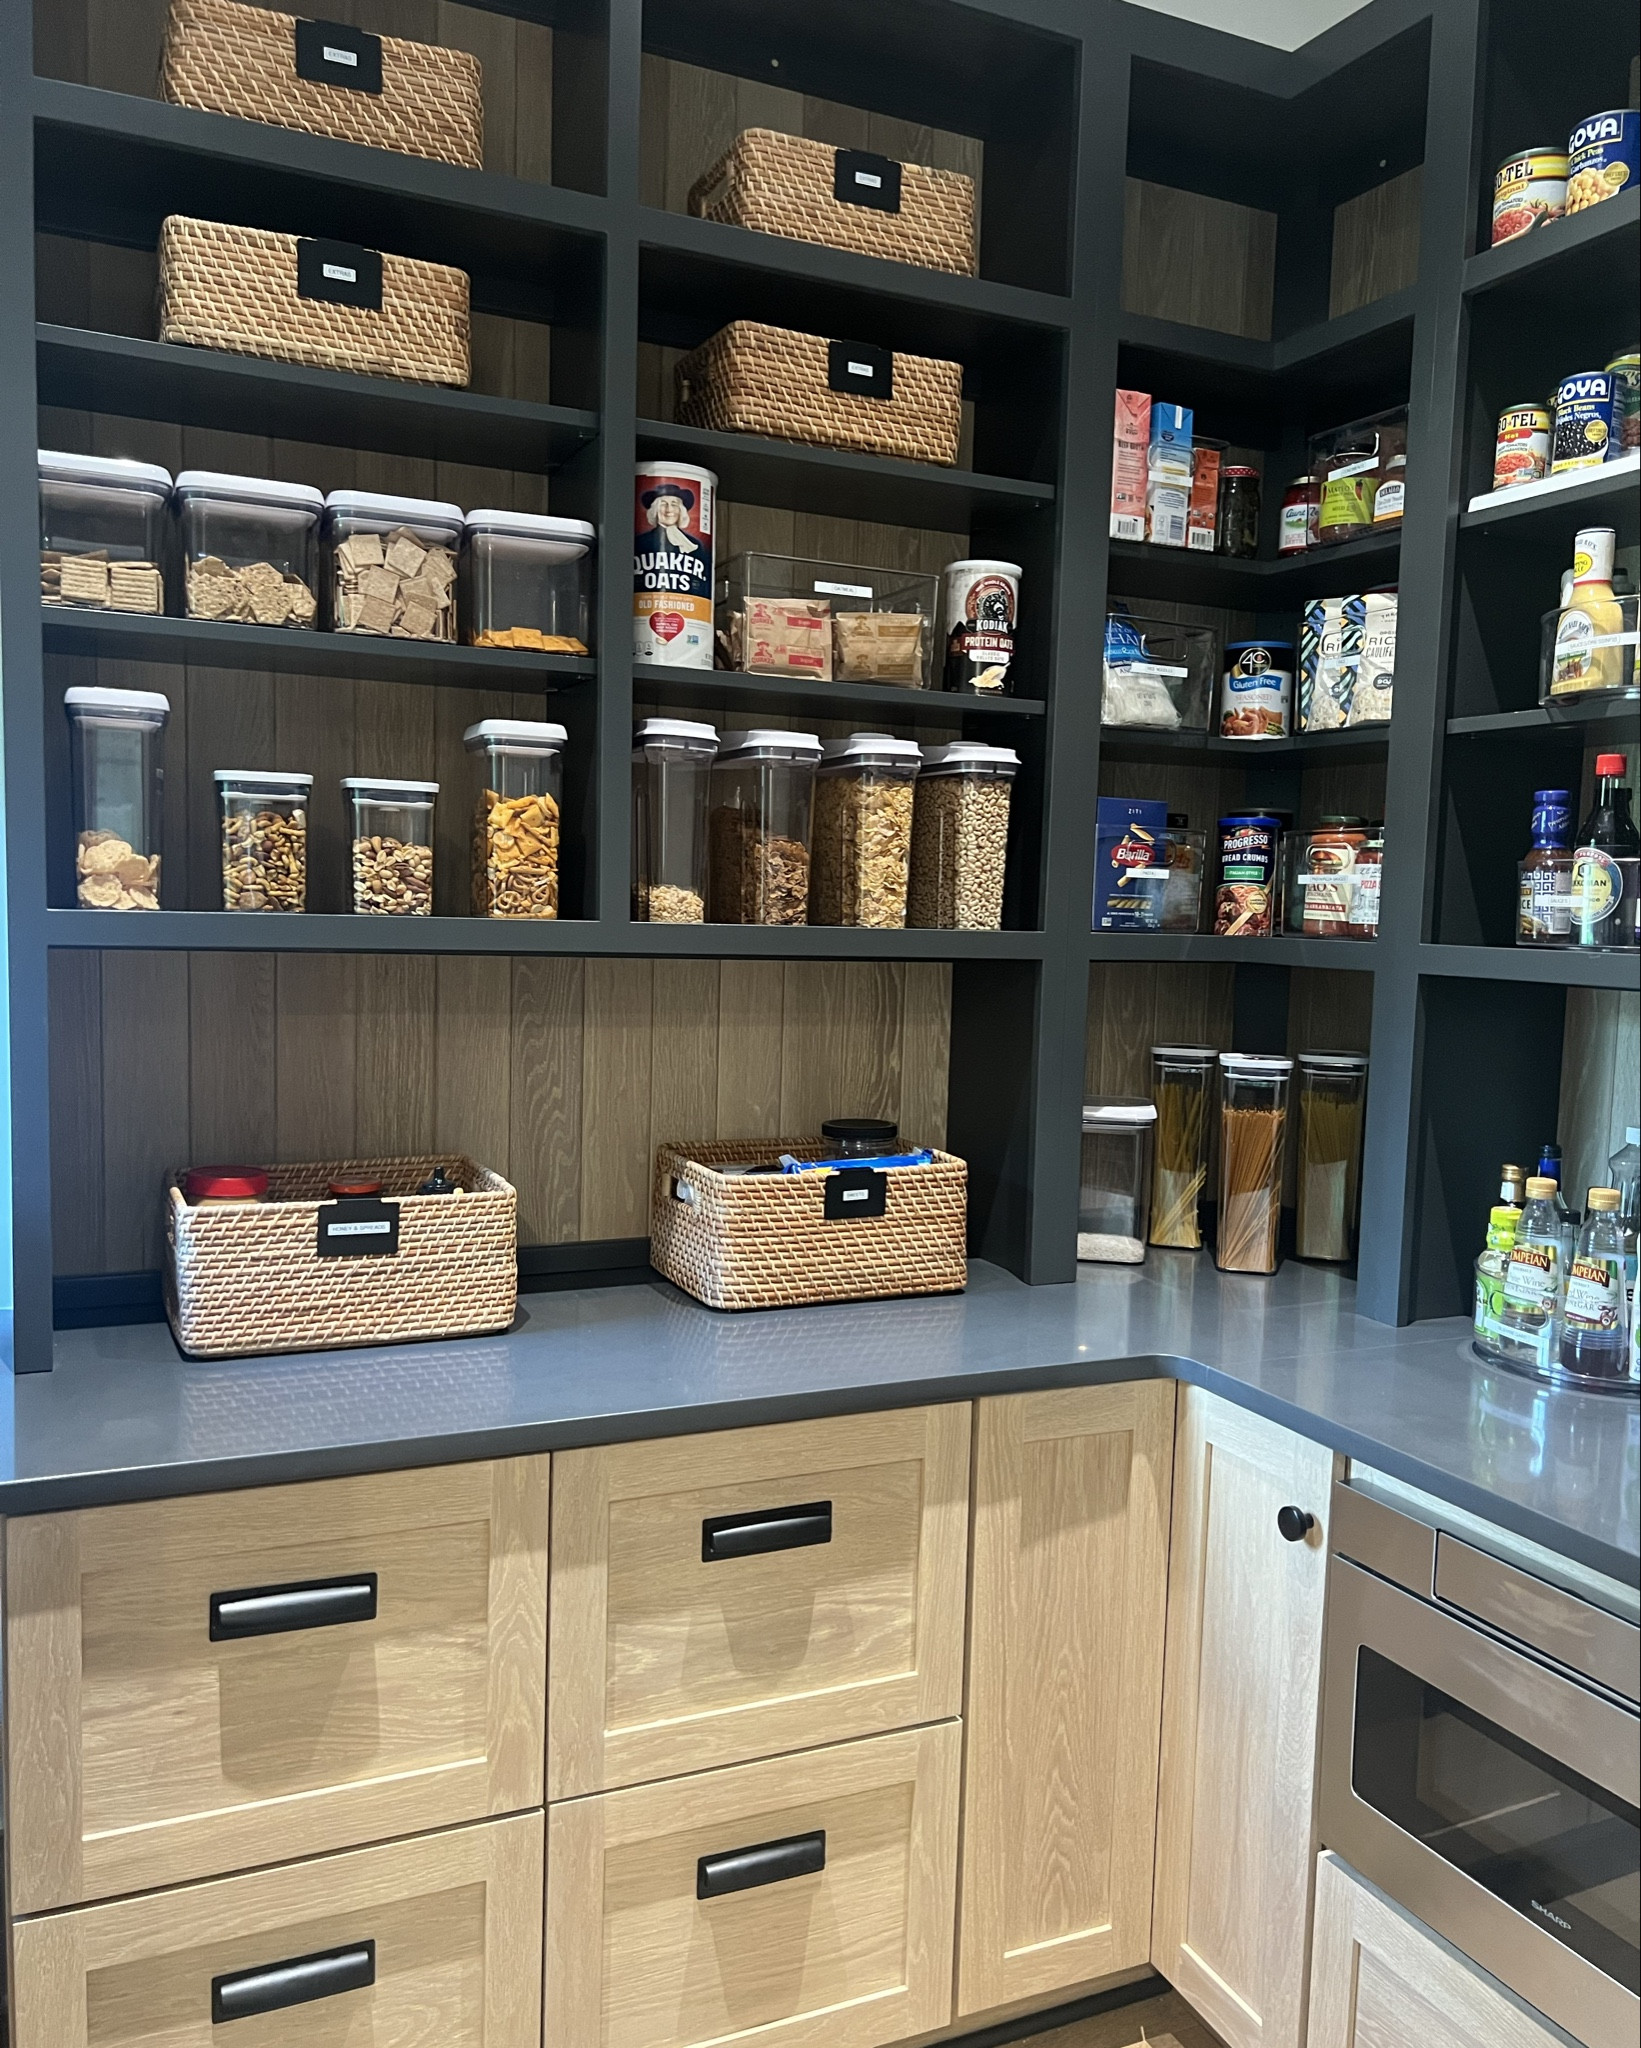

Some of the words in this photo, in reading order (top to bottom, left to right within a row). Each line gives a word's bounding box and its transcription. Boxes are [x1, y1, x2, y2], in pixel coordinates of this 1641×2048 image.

[1569, 118, 1618, 153] GOYA
[1558, 379, 1607, 404] GOYA
[1286, 508, 1306, 519] Aunt
[633, 552, 706, 581] QUAKER
[645, 572, 691, 591] OATS
[638, 599, 653, 609] OLD
[654, 599, 695, 612] FASHIONED
[751, 617, 775, 625] QUAKER
[976, 619, 1009, 634] KODIAK
[964, 636, 998, 648] PROTEIN
[999, 638, 1014, 650] OATS
[1326, 642, 1341, 652] RI
[752, 657, 776, 665] QUAKER
[1241, 651, 1266, 674] 4C
[1232, 680, 1258, 689] Gluten
[1259, 677, 1277, 686] Free
[1223, 835, 1268, 850] PROGRESSO
[1116, 848, 1152, 861] Barilla
[1221, 853, 1241, 863] BREAD
[1242, 853, 1269, 864] CRUMBS
[1360, 880, 1377, 889] PIZZA
[1531, 1899, 1572, 1930] SHARP
